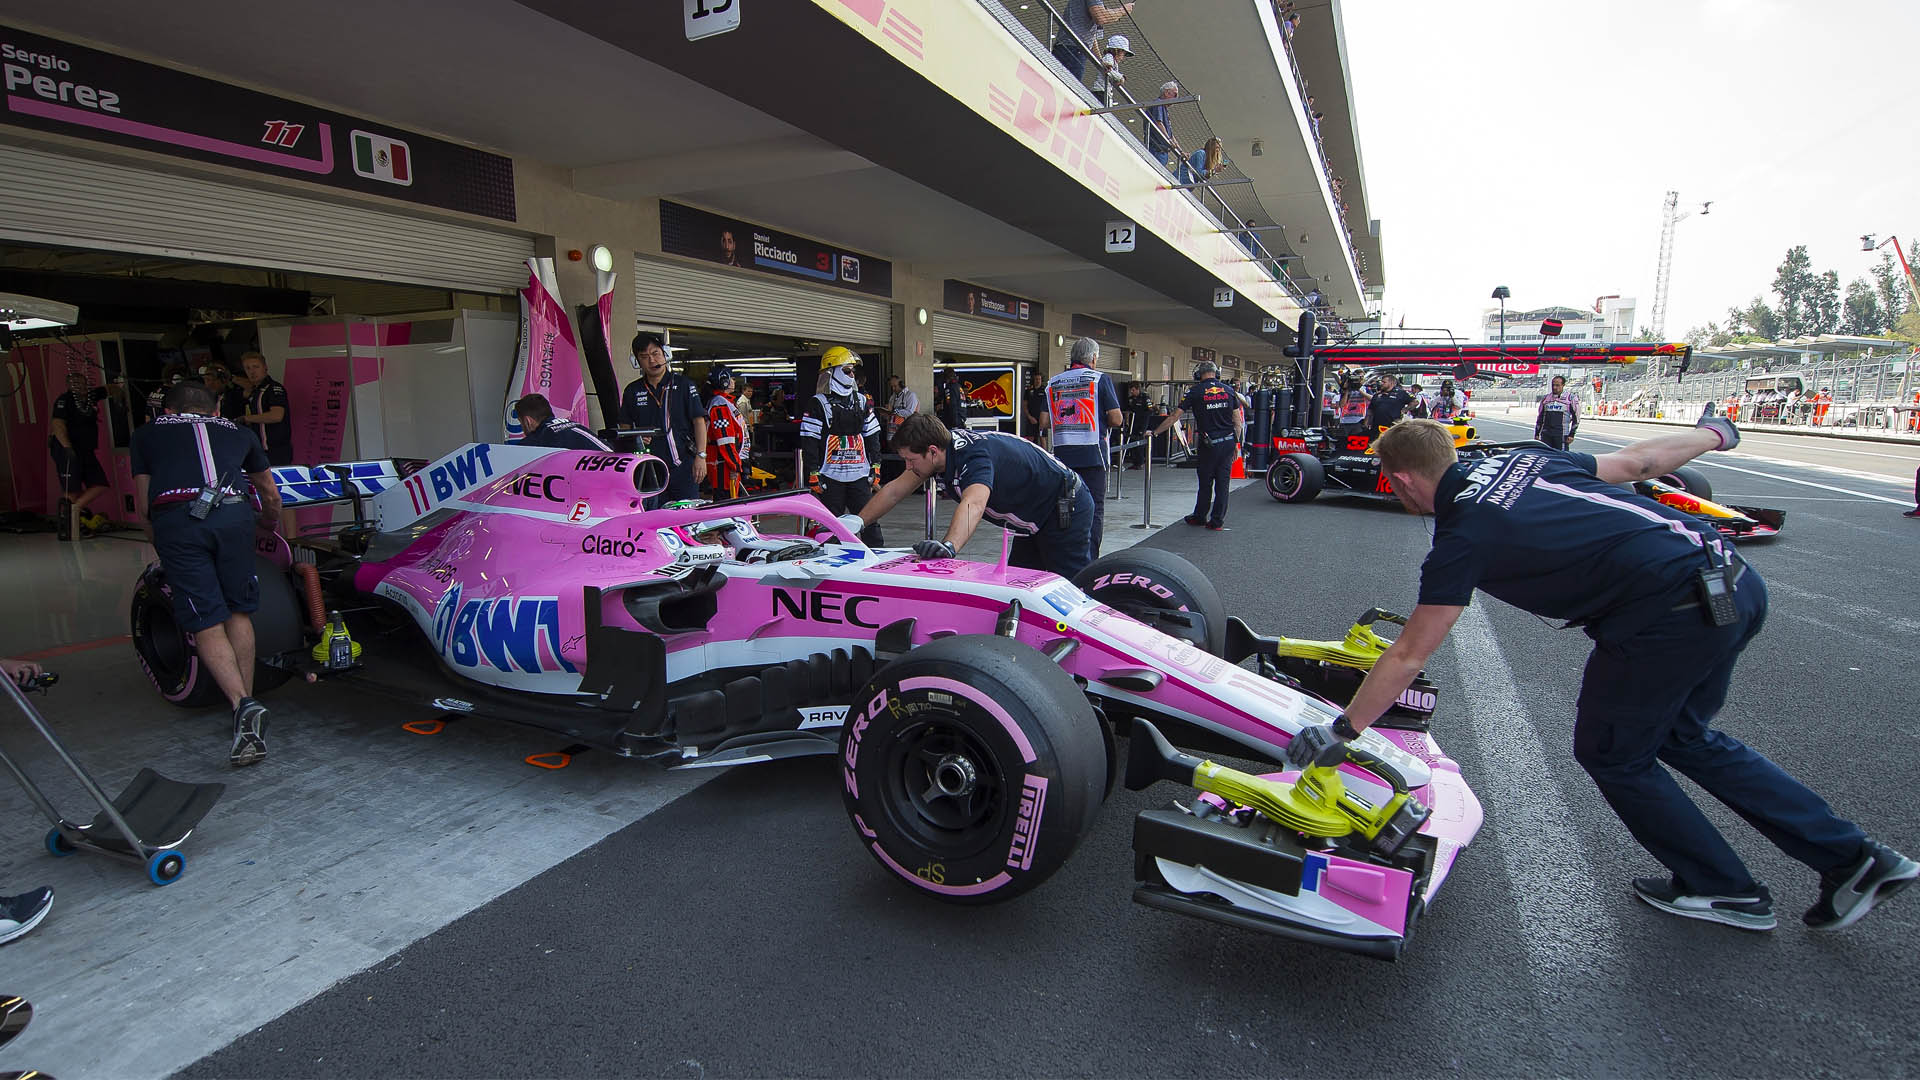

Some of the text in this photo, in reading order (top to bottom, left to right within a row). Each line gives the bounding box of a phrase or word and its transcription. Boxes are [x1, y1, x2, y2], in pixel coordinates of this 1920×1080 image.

[1, 43, 71, 72] Sergio
[4, 63, 121, 113] Perez
[261, 120, 304, 148] 11
[1013, 58, 1107, 193] DHL
[1109, 228, 1132, 245] 12
[754, 242, 797, 264] Ricciardo
[816, 252, 829, 271] 3
[1216, 292, 1231, 303] 11
[1264, 319, 1276, 329] 10
[1278, 440, 1306, 452] Mobil
[1346, 435, 1369, 450] 33
[432, 444, 495, 502] BWT
[575, 455, 634, 473] HYPE
[507, 473, 567, 503] NEC
[1486, 454, 1540, 505] MAGNESIUM
[404, 475, 431, 516] 11
[571, 503, 587, 521] E
[582, 530, 646, 557] Claro
[692, 551, 723, 561] PEMEX
[1092, 572, 1176, 599] ZERO
[771, 588, 880, 629] NEC
[449, 596, 579, 674] BWT
[844, 688, 888, 800] ZERO
[1006, 773, 1048, 872] PIRELLI
